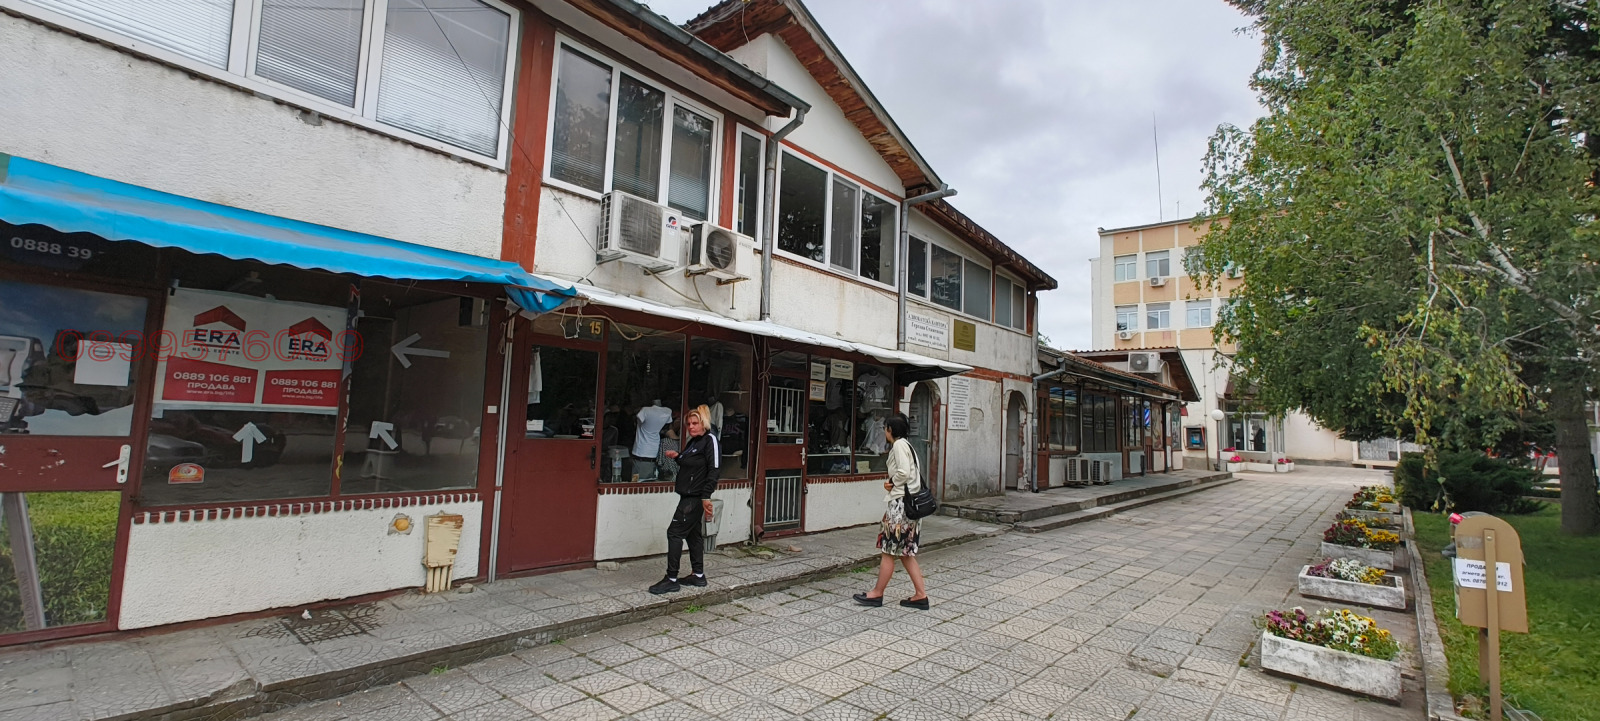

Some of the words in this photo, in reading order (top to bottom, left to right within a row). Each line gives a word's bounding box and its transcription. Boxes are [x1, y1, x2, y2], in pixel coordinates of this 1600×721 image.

[10, 237, 62, 255] 0888
[67, 246, 92, 260] 39
[589, 320, 602, 335] 15
[194, 328, 240, 346] ERA
[288, 338, 328, 353] ERA
[173, 371, 206, 381] 0889
[209, 373, 230, 382] 106
[232, 375, 252, 384] 881
[271, 377, 298, 386] 0889
[301, 379, 319, 388] 106
[321, 381, 337, 389] 881
[187, 381, 236, 391] ПРОДАВА
[282, 387, 323, 395] ПРОДАВА
